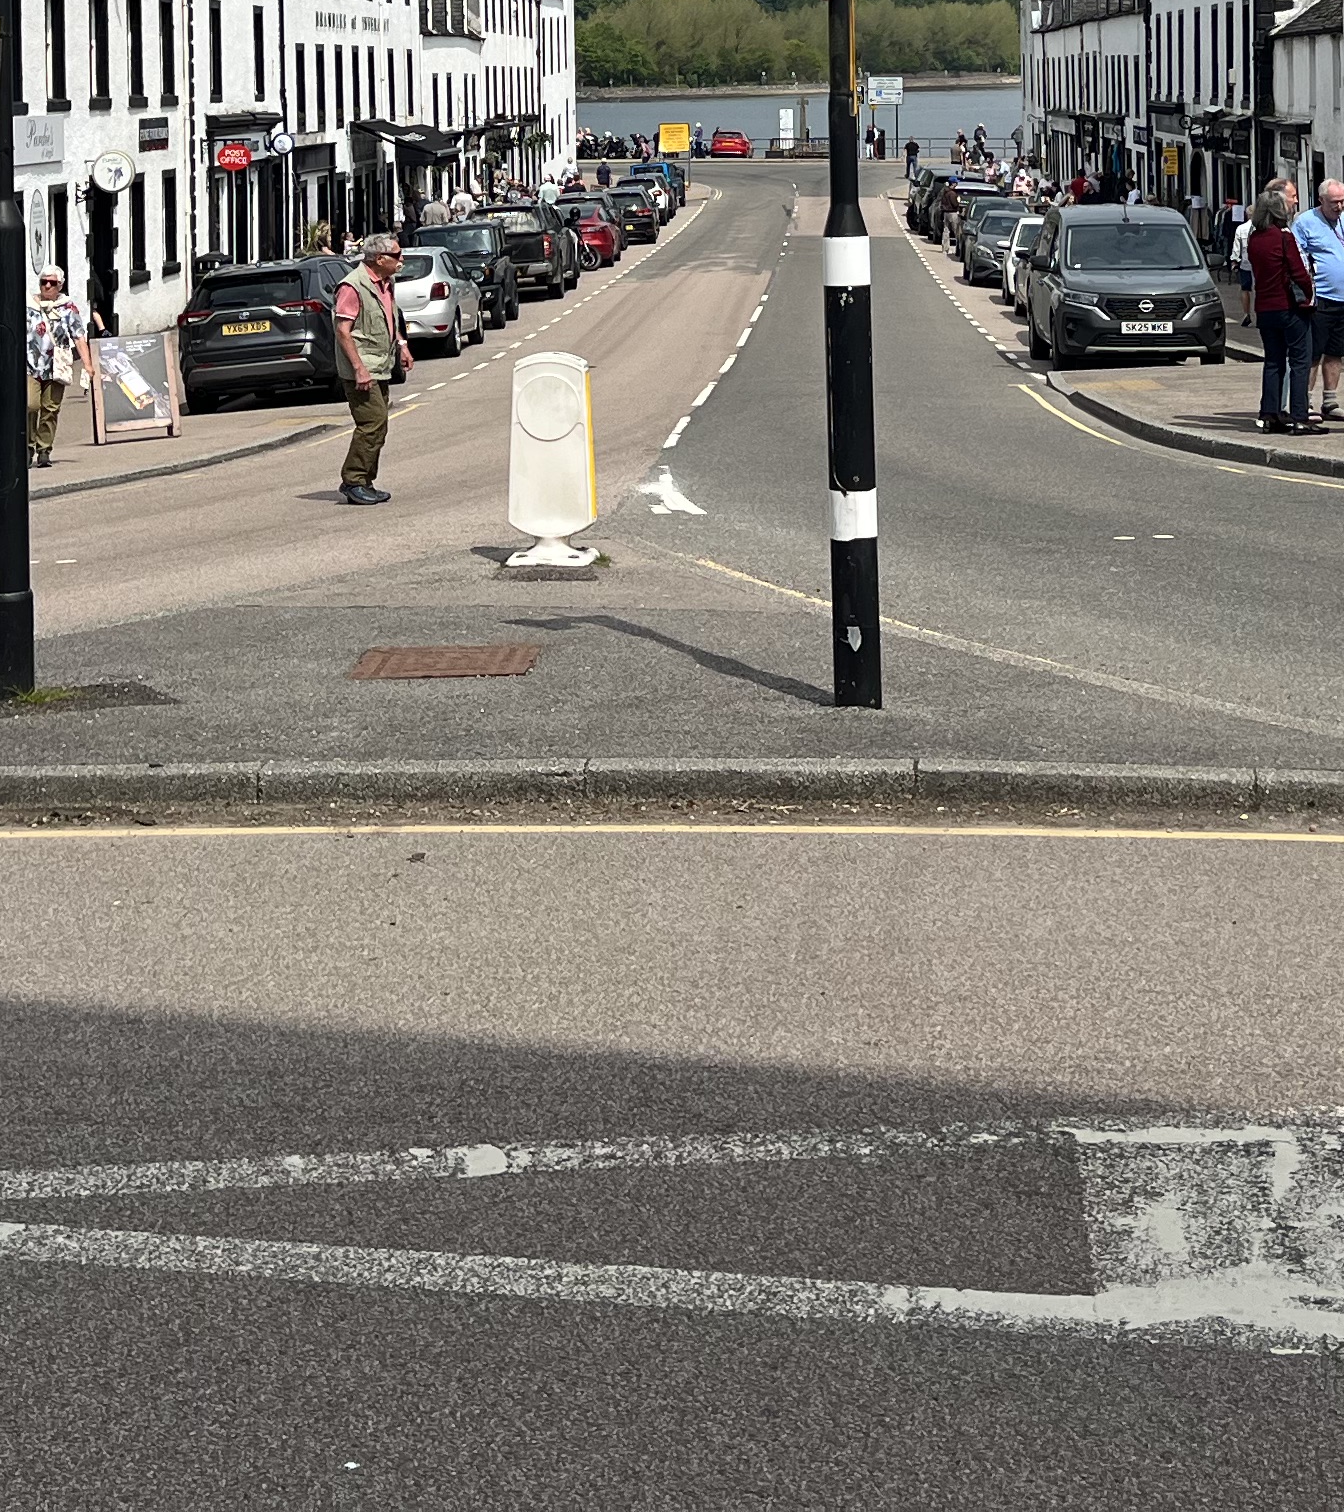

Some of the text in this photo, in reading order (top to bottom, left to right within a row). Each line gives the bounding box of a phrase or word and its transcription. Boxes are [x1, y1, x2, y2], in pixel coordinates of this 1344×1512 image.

[224, 149, 245, 157] POST
[219, 156, 248, 165] OFFICE
[1125, 323, 1149, 332] SK25
